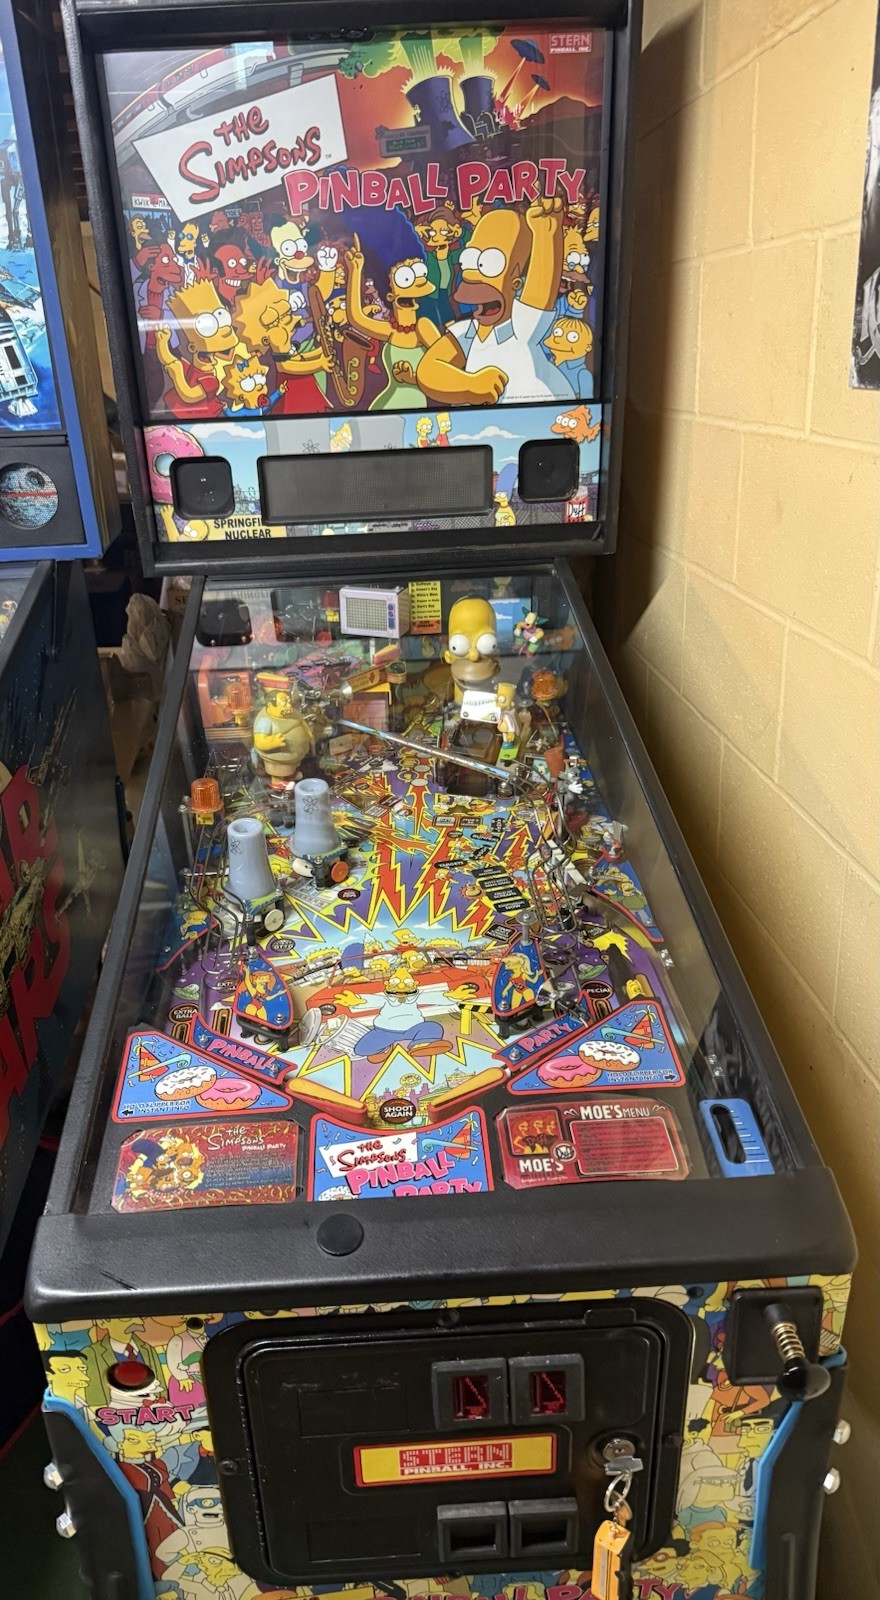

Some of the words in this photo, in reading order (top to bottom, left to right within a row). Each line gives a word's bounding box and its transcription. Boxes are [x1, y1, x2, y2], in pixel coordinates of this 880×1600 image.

[551, 33, 590, 46] STERN
[283, 162, 448, 216] PINBALL
[456, 158, 586, 210] PARTY
[213, 517, 261, 529] SPRINGFI
[224, 528, 271, 540] NUCLEAR
[517, 1022, 573, 1052] PARTY
[206, 1039, 276, 1070] PINBALL
[137, 1106, 171, 1114] INSTANT
[145, 1100, 175, 1108] FLIPPER
[384, 1105, 414, 1113] SHOOT
[579, 1105, 623, 1120] MOE'S
[623, 1108, 650, 1118] MENU
[345, 1150, 455, 1195] PINBALL
[519, 1158, 564, 1173] MOE'S
[97, 1404, 196, 1426] START
[403, 1443, 509, 1467] STERN
[404, 1464, 472, 1475] PINBALL,
[478, 1461, 510, 1470] INC.
